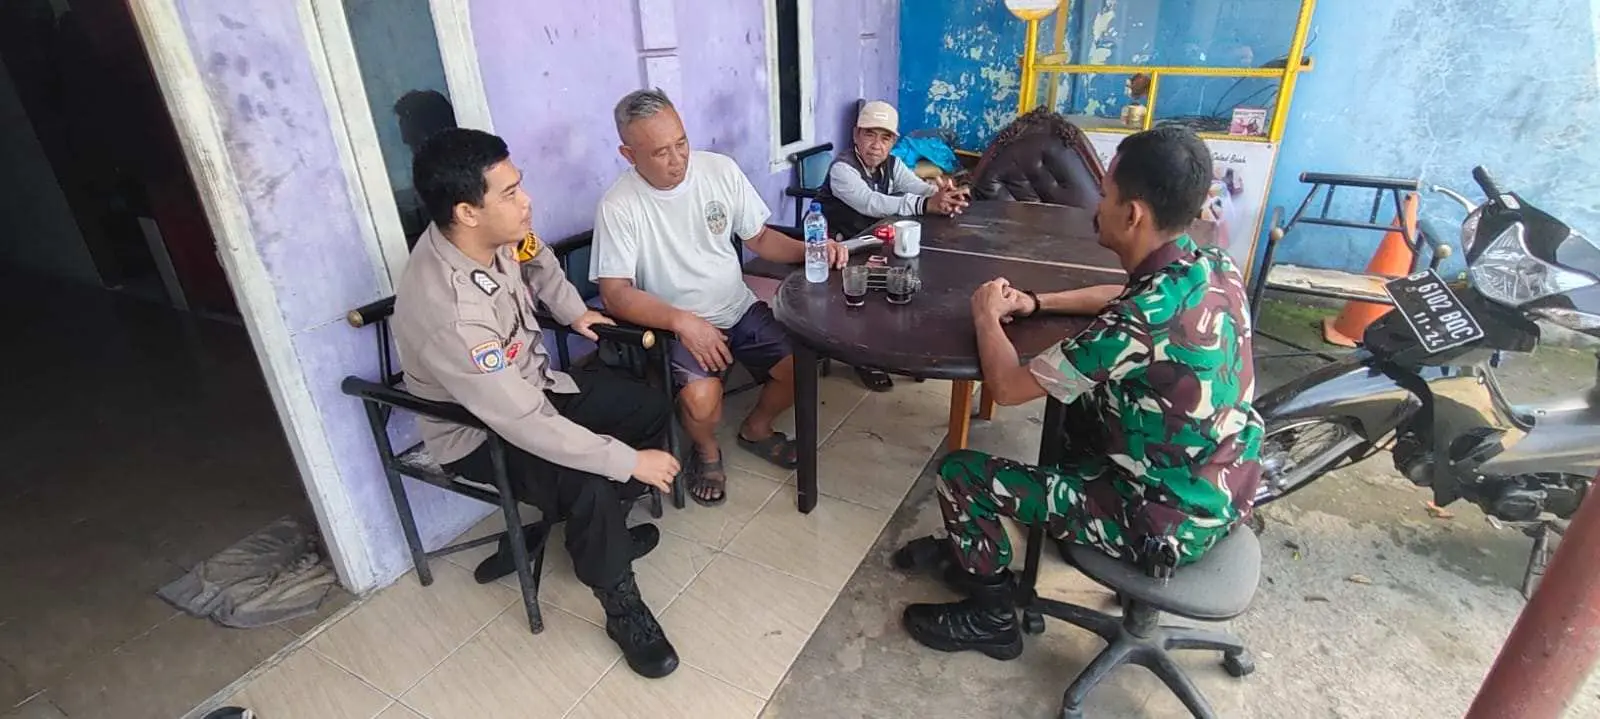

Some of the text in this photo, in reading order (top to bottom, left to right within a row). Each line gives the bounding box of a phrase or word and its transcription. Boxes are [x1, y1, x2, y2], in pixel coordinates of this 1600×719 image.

[1407, 270, 1474, 339] B 6102 BQC
